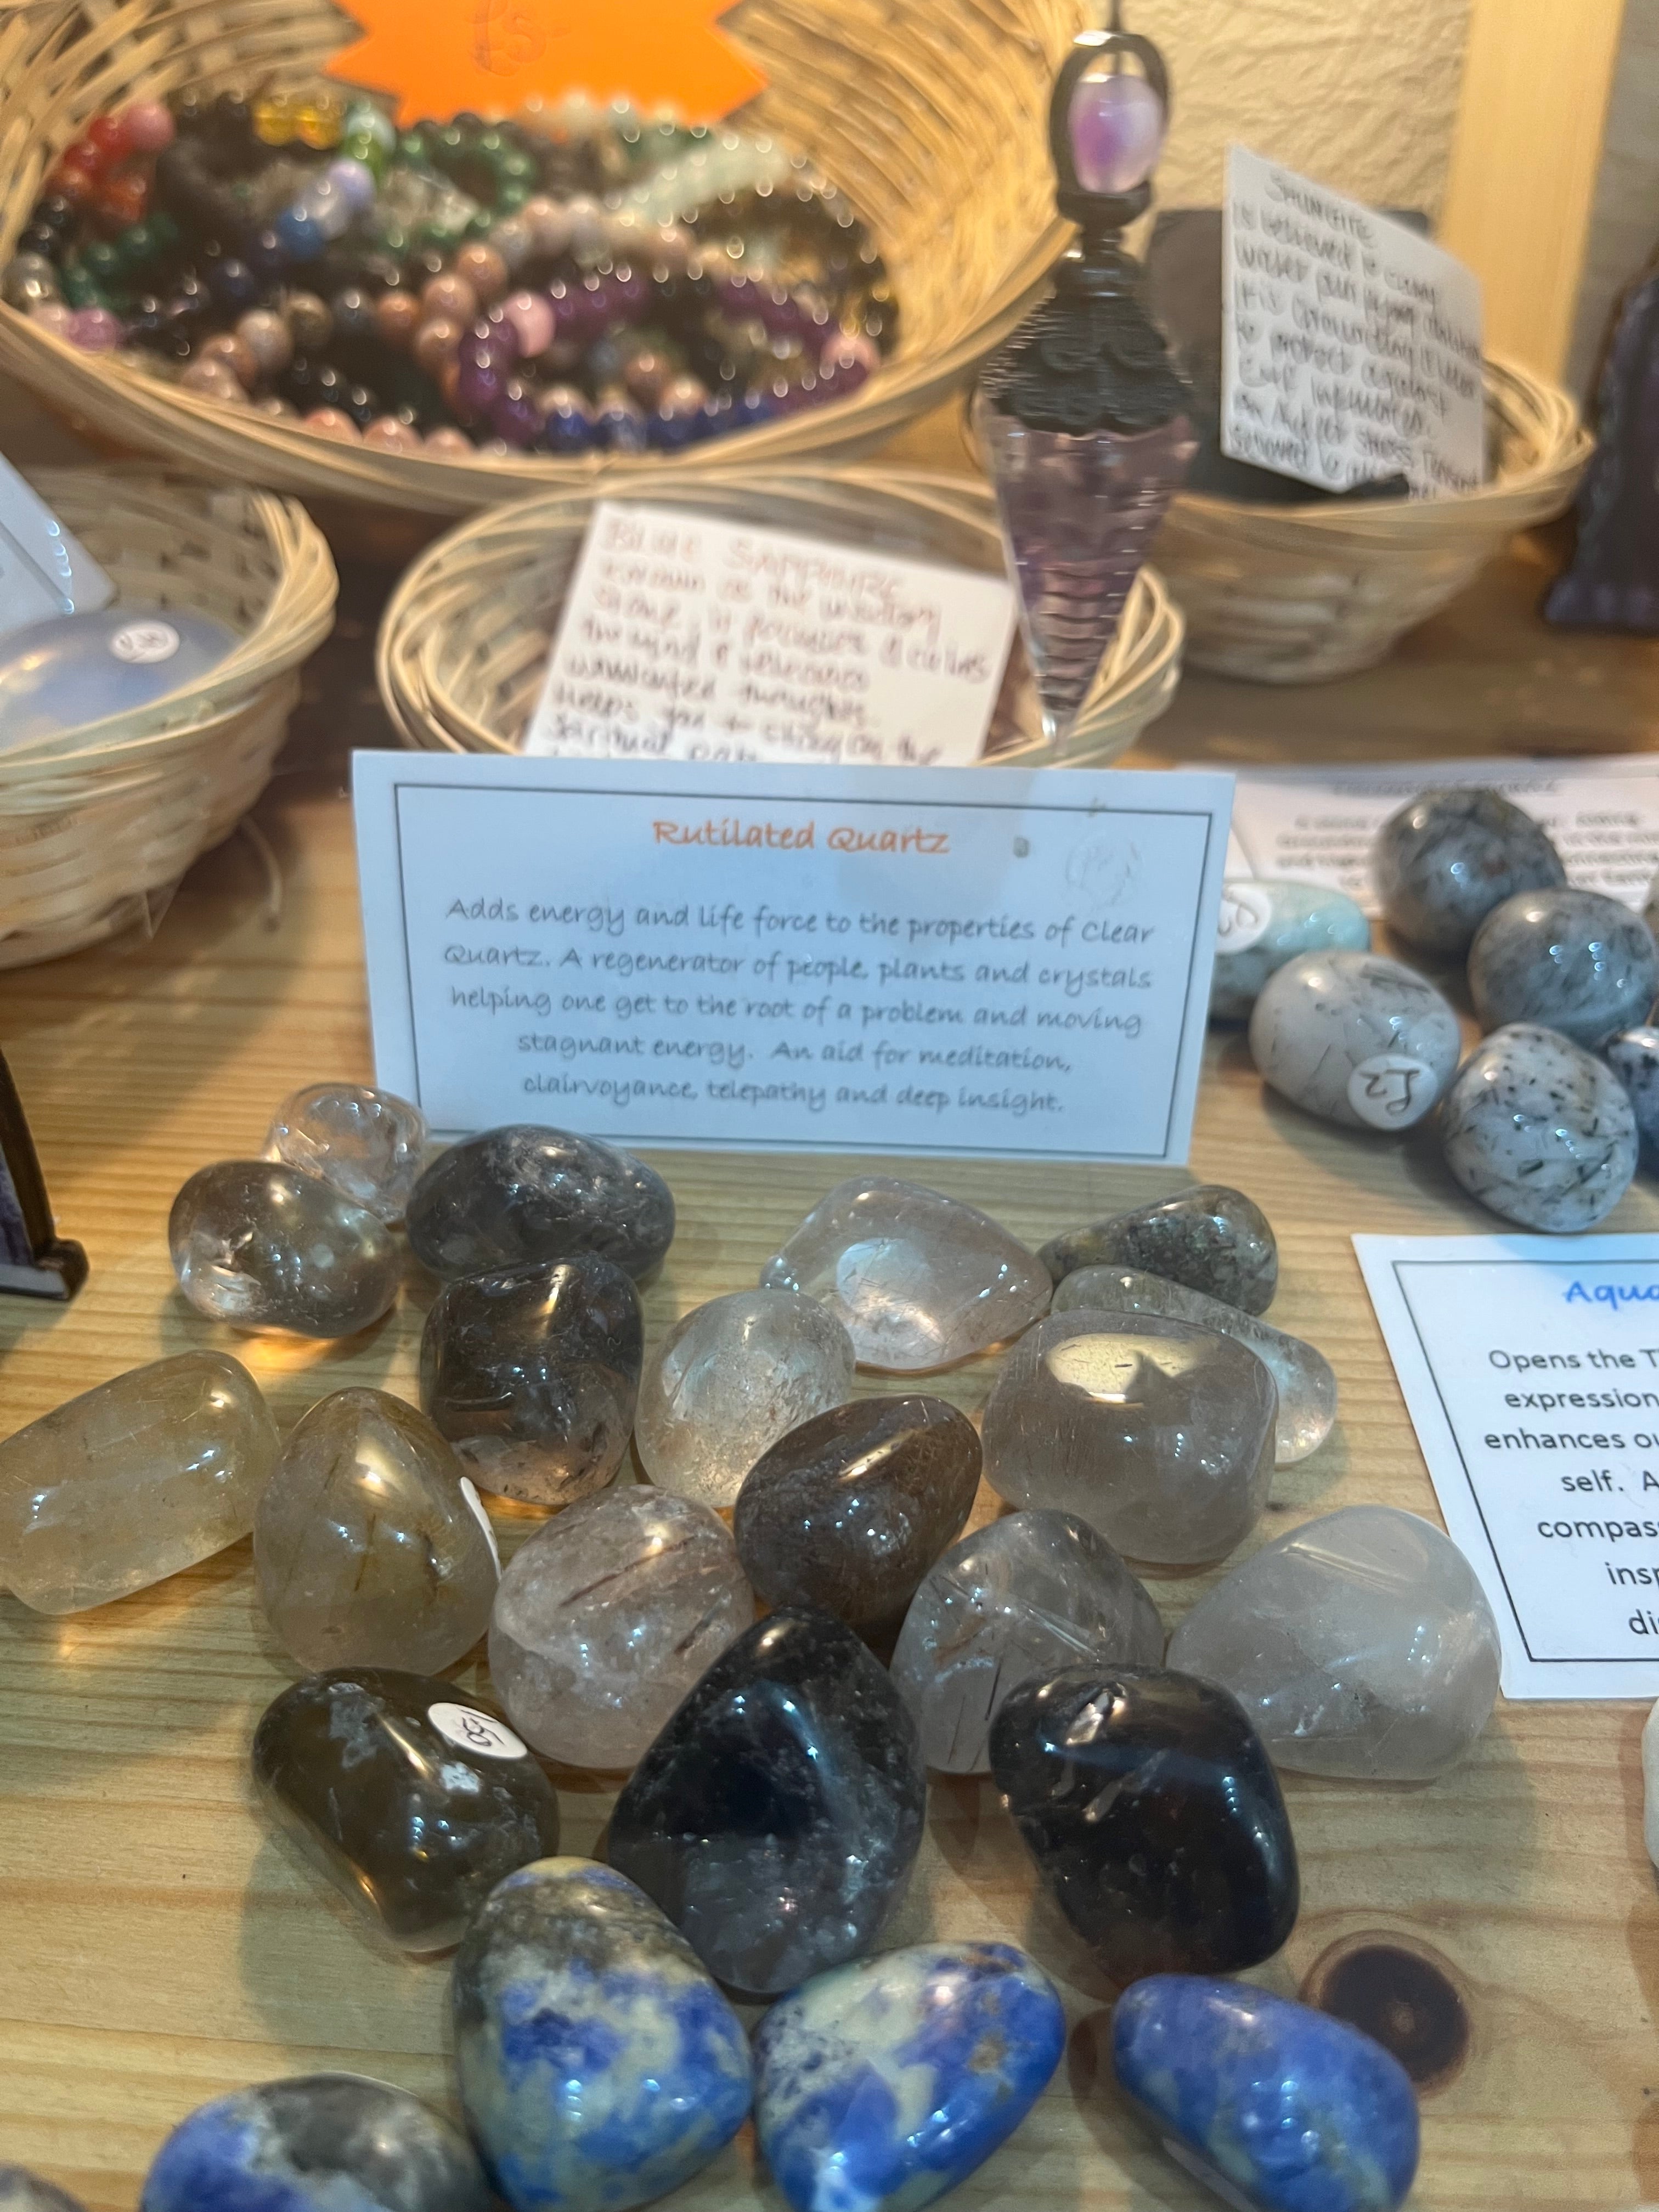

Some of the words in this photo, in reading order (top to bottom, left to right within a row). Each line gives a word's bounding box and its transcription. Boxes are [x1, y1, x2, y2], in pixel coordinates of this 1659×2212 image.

[653, 818, 814, 849] Rutilated
[827, 827, 949, 853] Quartz
[445, 897, 519, 921] Adds
[529, 904, 624, 937] energy
[635, 905, 689, 927] and
[699, 904, 743, 935] life
[753, 904, 817, 938] force
[826, 912, 851, 933] to
[859, 913, 899, 935] the
[907, 915, 1035, 944] properties
[1045, 915, 1075, 949] of
[443, 945, 550, 967] Quartz.
[592, 952, 744, 977] regenerator
[753, 951, 782, 981] of
[878, 958, 965, 986] plants
[975, 961, 1030, 983] and
[1039, 967, 1152, 998] crystals
[451, 986, 551, 1017] helping
[562, 995, 606, 1012] one
[614, 996, 656, 1020] get
[663, 997, 689, 1015] to
[697, 995, 736, 1017] the
[745, 998, 794, 1018] root
[802, 995, 832, 1026] of
[837, 1005, 851, 1019] a
[861, 1000, 963, 1027] problem
[973, 1005, 1028, 1026] and
[1037, 1008, 1142, 1039] moving
[518, 1033, 645, 1060] stagnant
[652, 1039, 753, 1071] energy.
[771, 1041, 813, 1060] An
[821, 1040, 864, 1063] aid
[872, 1040, 911, 1070] for
[919, 1045, 1071, 1073] meditation,
[706, 1081, 826, 1113] telepathy
[836, 1084, 888, 1104] and
[896, 1085, 950, 1113] deep
[958, 1087, 1063, 1118] insight.
[1489, 1350, 1581, 1373] Opens
[1587, 1349, 1636, 1368] the
[1485, 1427, 1626, 1449] enhances
[1561, 1470, 1624, 1492] self.
[1538, 1521, 1659, 1542] compas
